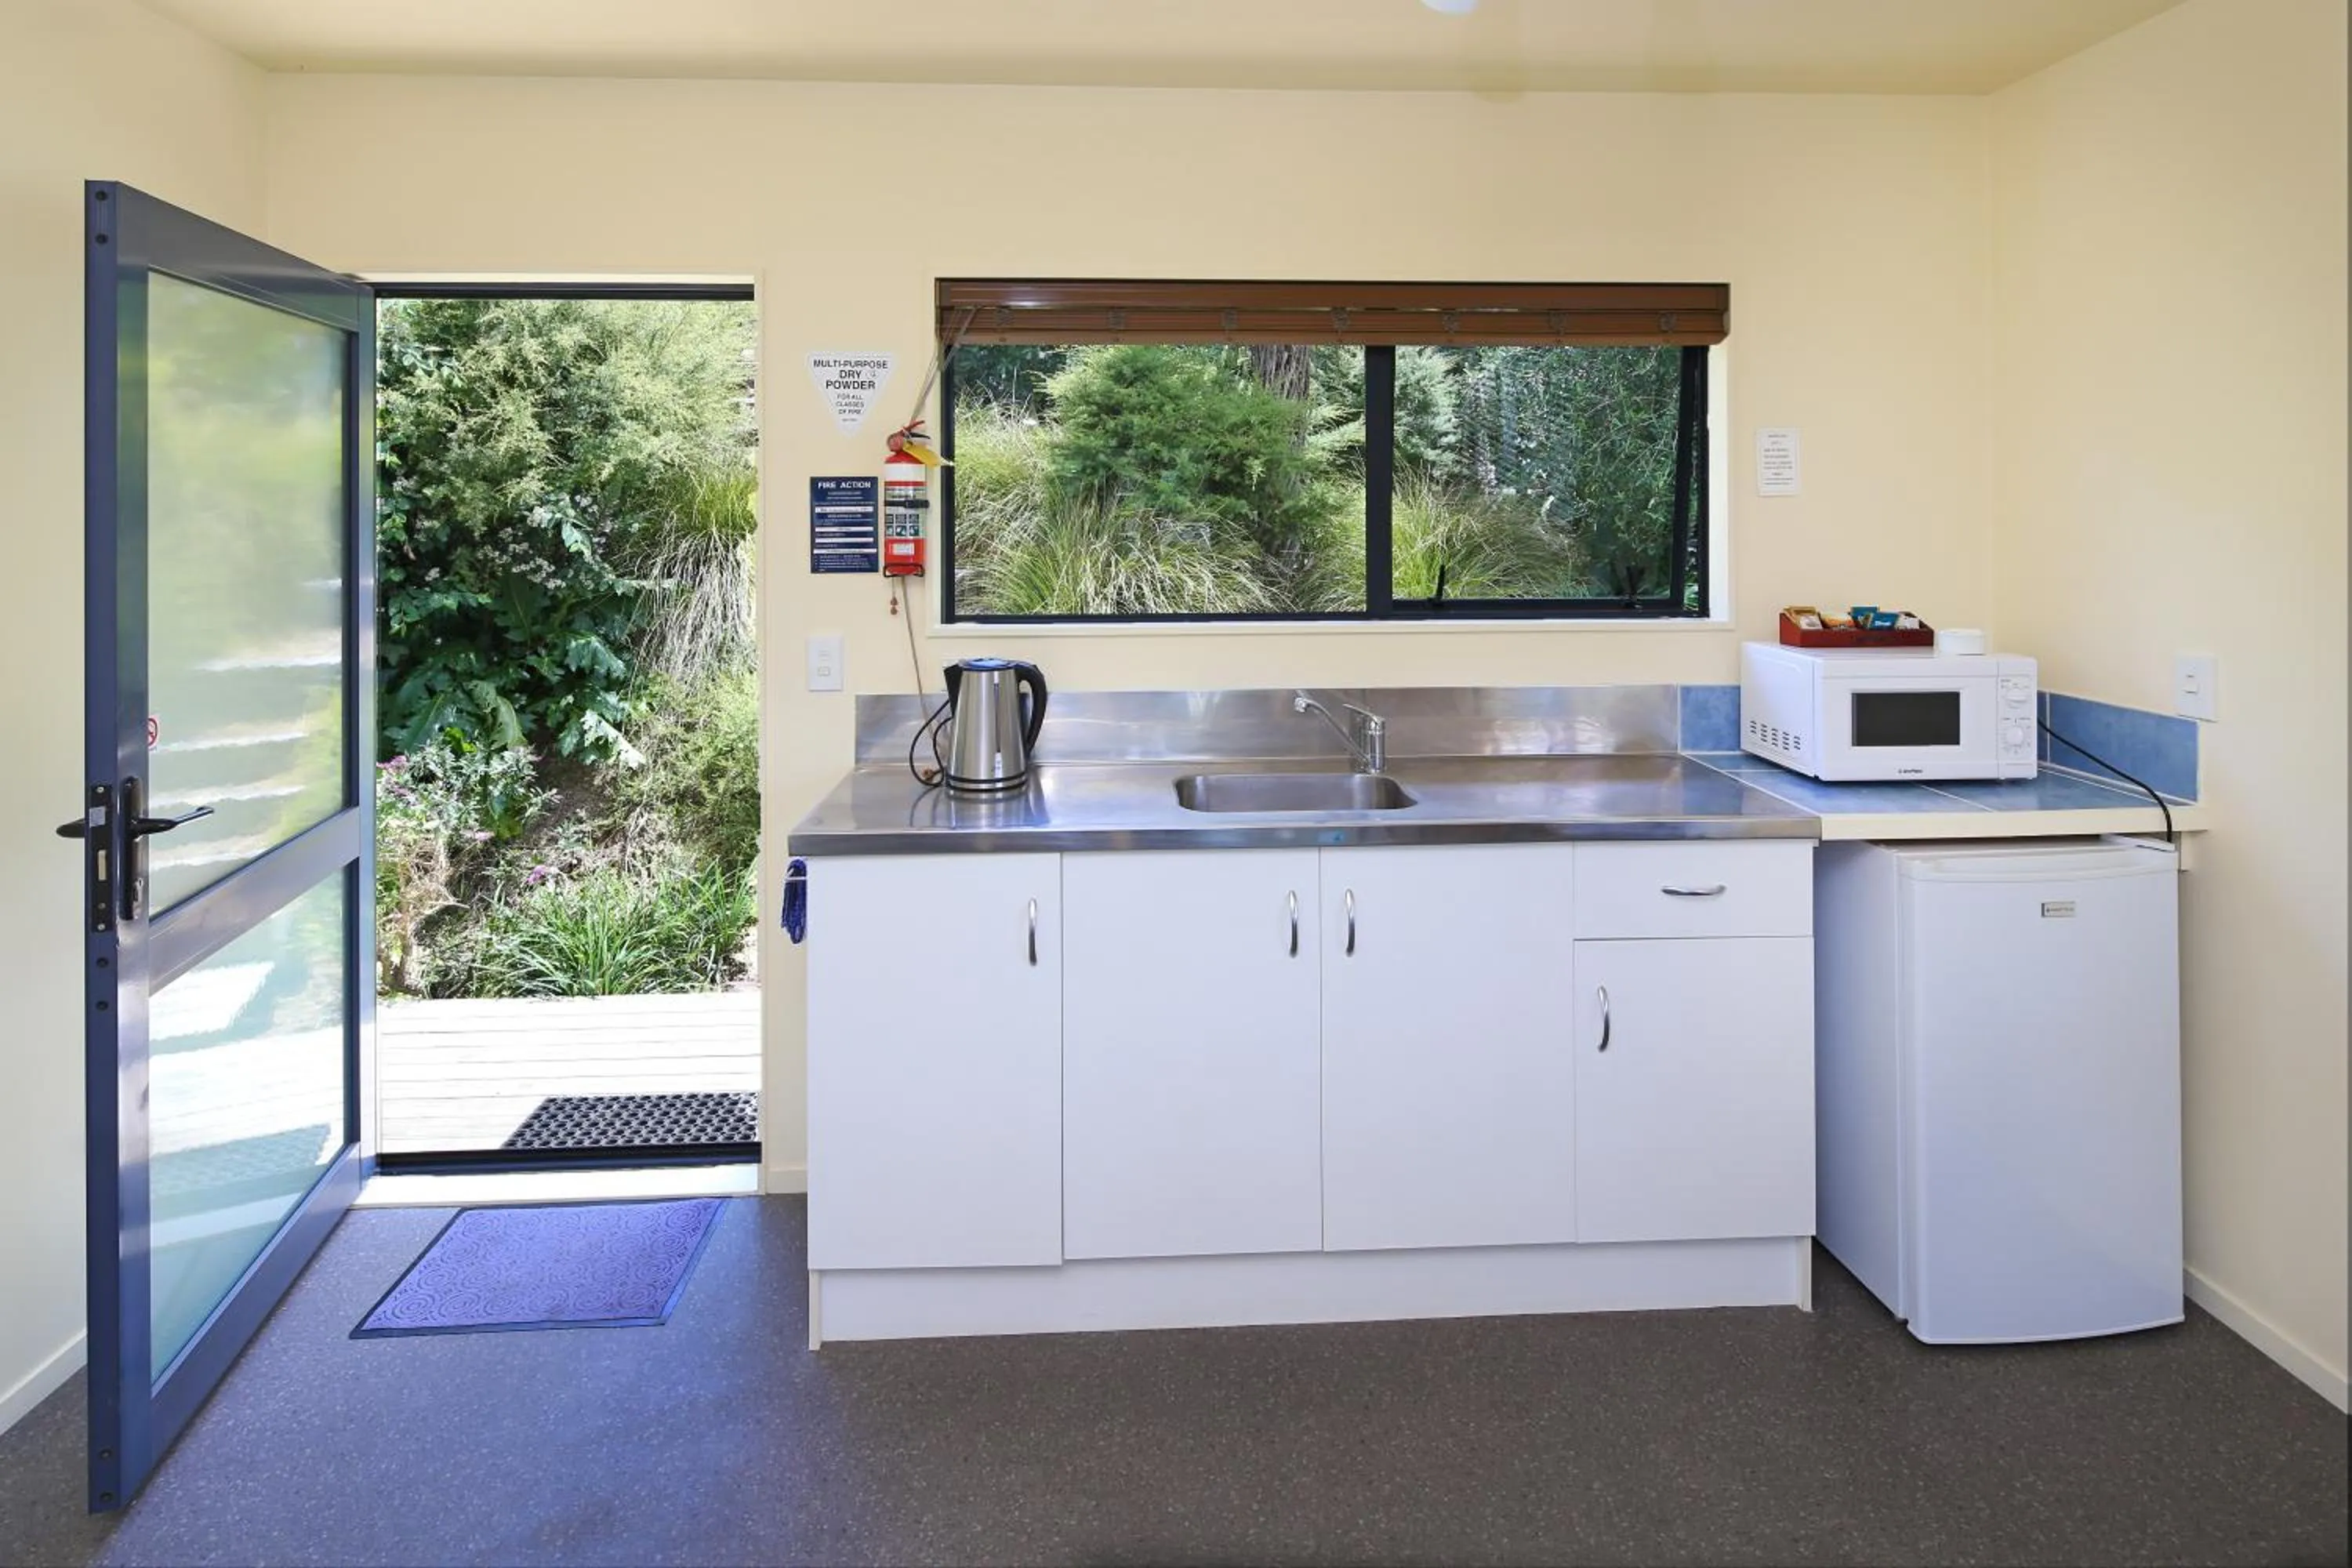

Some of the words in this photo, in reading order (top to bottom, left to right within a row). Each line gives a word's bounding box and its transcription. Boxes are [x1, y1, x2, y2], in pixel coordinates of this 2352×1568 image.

[813, 359, 888, 368] MULTI-PURPOSE
[840, 370, 862, 379] DRY
[826, 380, 876, 390] POWDER
[818, 481, 837, 489] FIRE
[840, 481, 871, 489] ACTION
